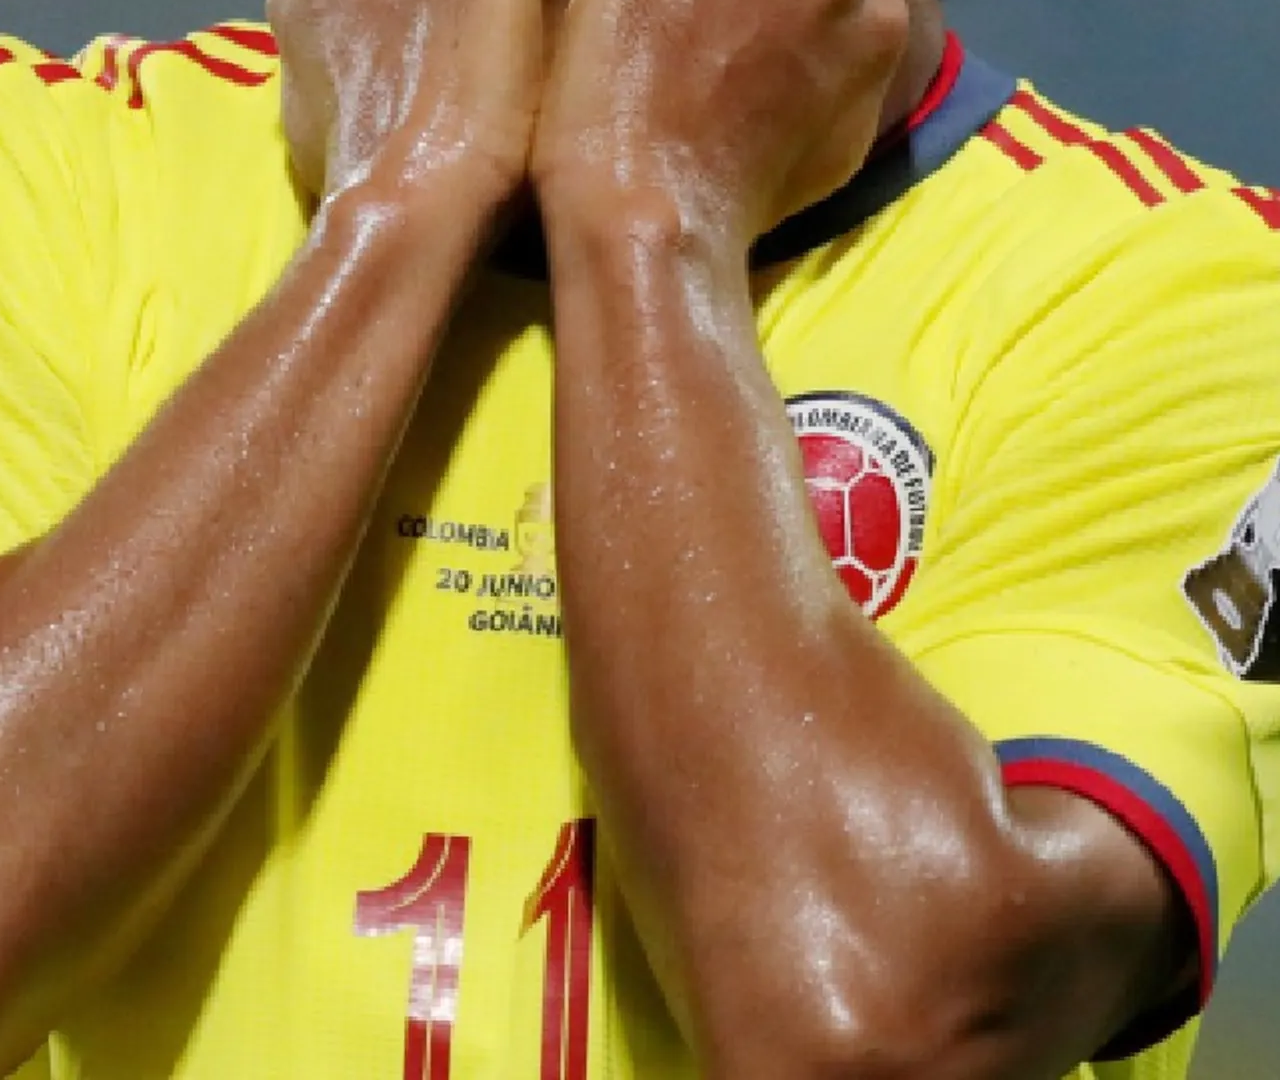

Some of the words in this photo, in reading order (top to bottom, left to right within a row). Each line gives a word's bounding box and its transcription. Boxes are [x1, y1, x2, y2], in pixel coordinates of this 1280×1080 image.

[397, 513, 510, 551] COLOMBIA
[436, 568, 473, 594] 20
[476, 573, 556, 600] JUNIO
[468, 605, 562, 637] GOIÂNI
[352, 817, 597, 1080] 11
